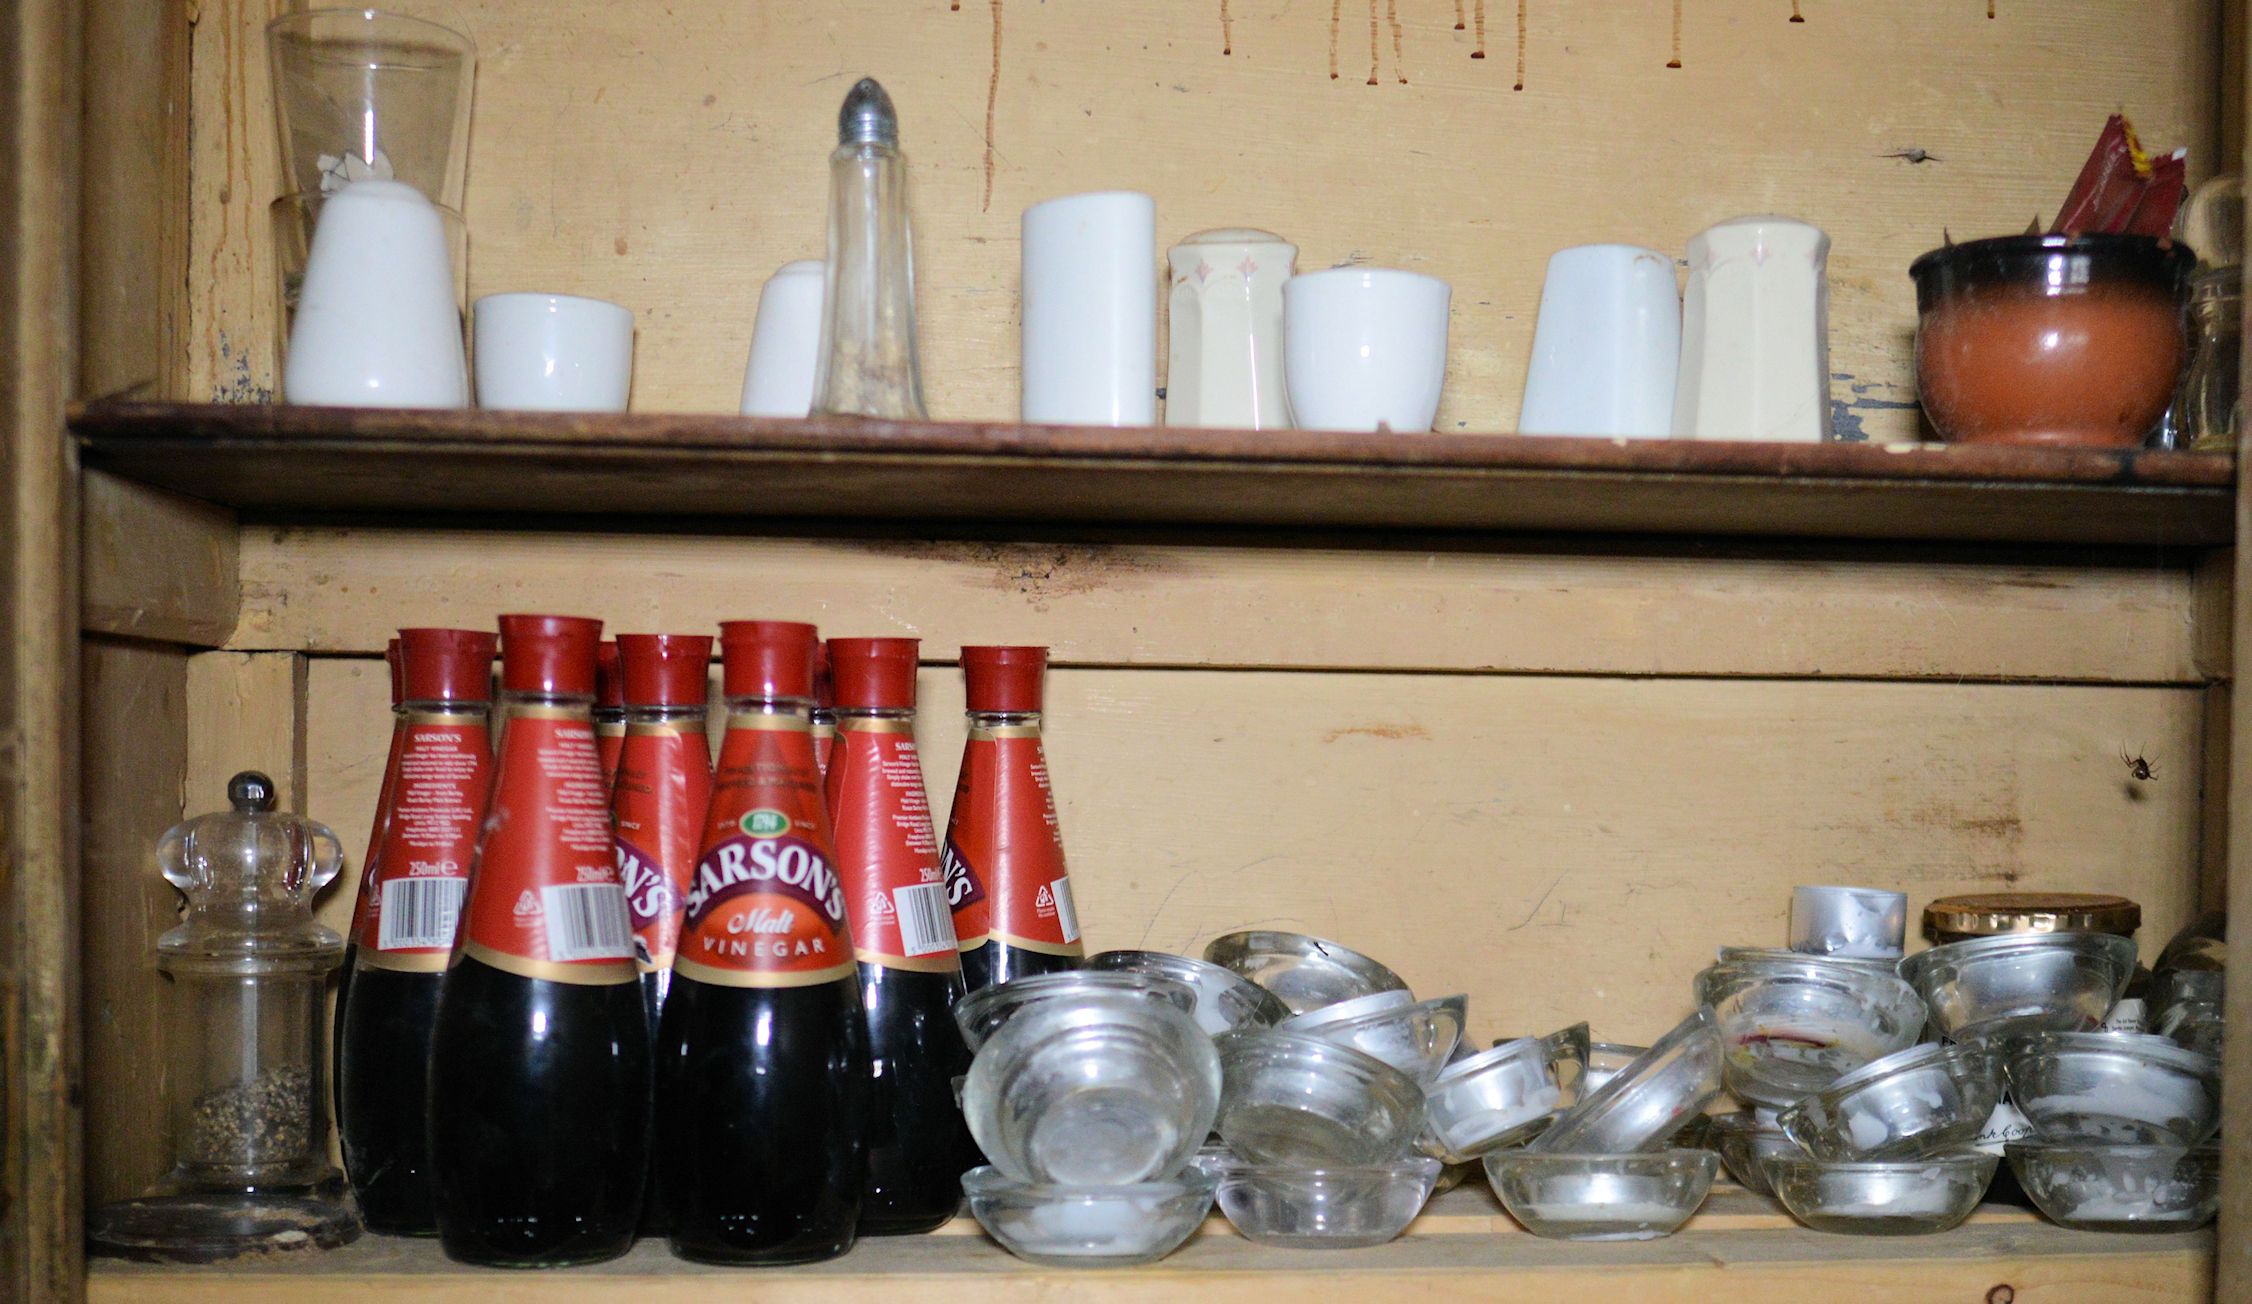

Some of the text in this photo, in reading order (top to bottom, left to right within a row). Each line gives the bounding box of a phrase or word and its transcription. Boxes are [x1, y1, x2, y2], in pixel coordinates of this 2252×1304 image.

[686, 839, 844, 921] SARSON'S
[727, 907, 795, 935] Malt
[702, 936, 826, 958] VINEGAR
